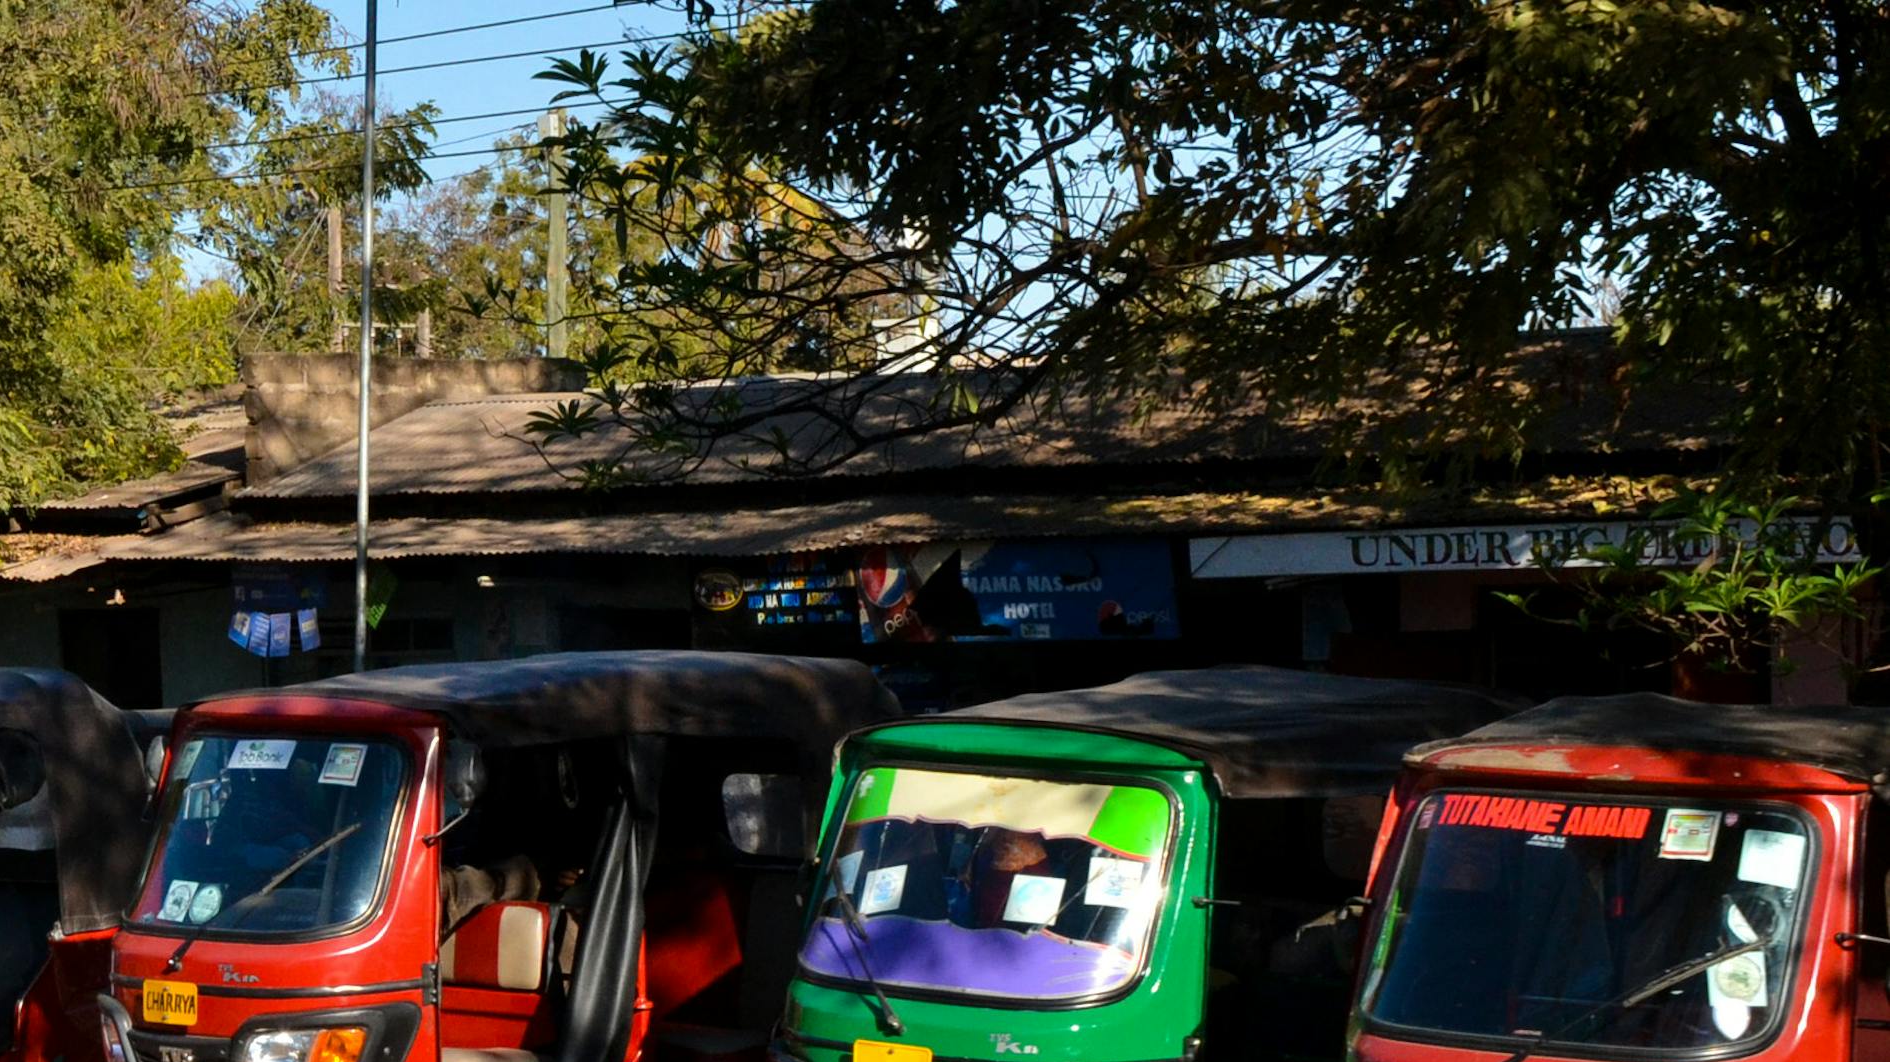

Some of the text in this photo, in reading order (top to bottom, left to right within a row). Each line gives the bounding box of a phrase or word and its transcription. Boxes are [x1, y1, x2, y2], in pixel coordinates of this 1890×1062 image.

[1346, 530, 1520, 566] UNDER
[1003, 602, 1056, 619] HOTEL
[1562, 806, 1653, 839] AMANI
[146, 989, 196, 1016] CHARRYA
